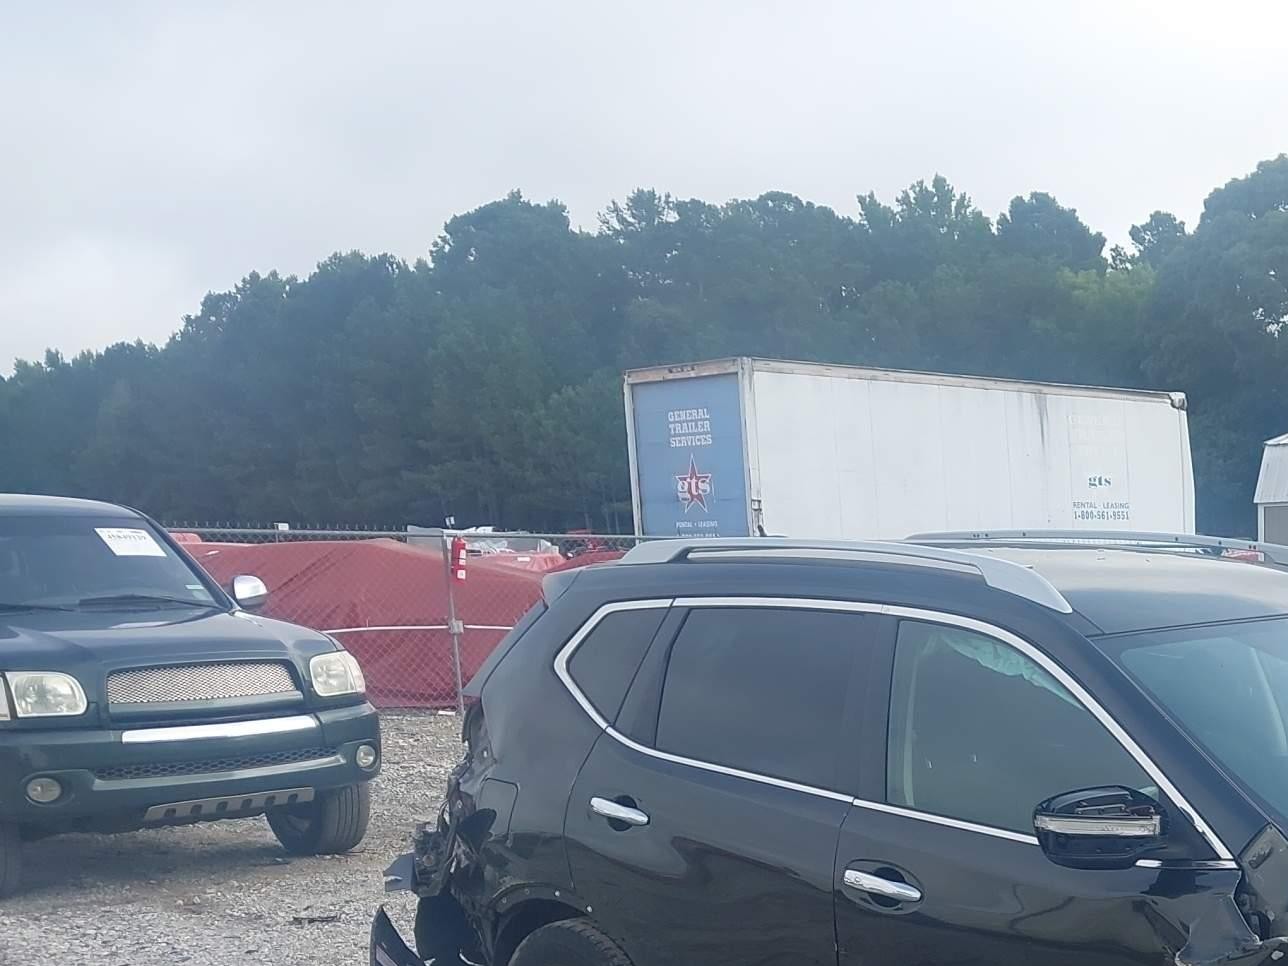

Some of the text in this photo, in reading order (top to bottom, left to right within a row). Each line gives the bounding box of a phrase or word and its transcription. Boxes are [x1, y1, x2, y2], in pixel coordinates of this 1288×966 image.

[668, 408, 710, 421] GENERAL
[669, 420, 711, 434] TRAILER
[670, 434, 712, 447] SERVICES
[1088, 475, 1112, 488] gts
[677, 476, 711, 503] gts
[1073, 501, 1130, 509] RENTAL LEASING
